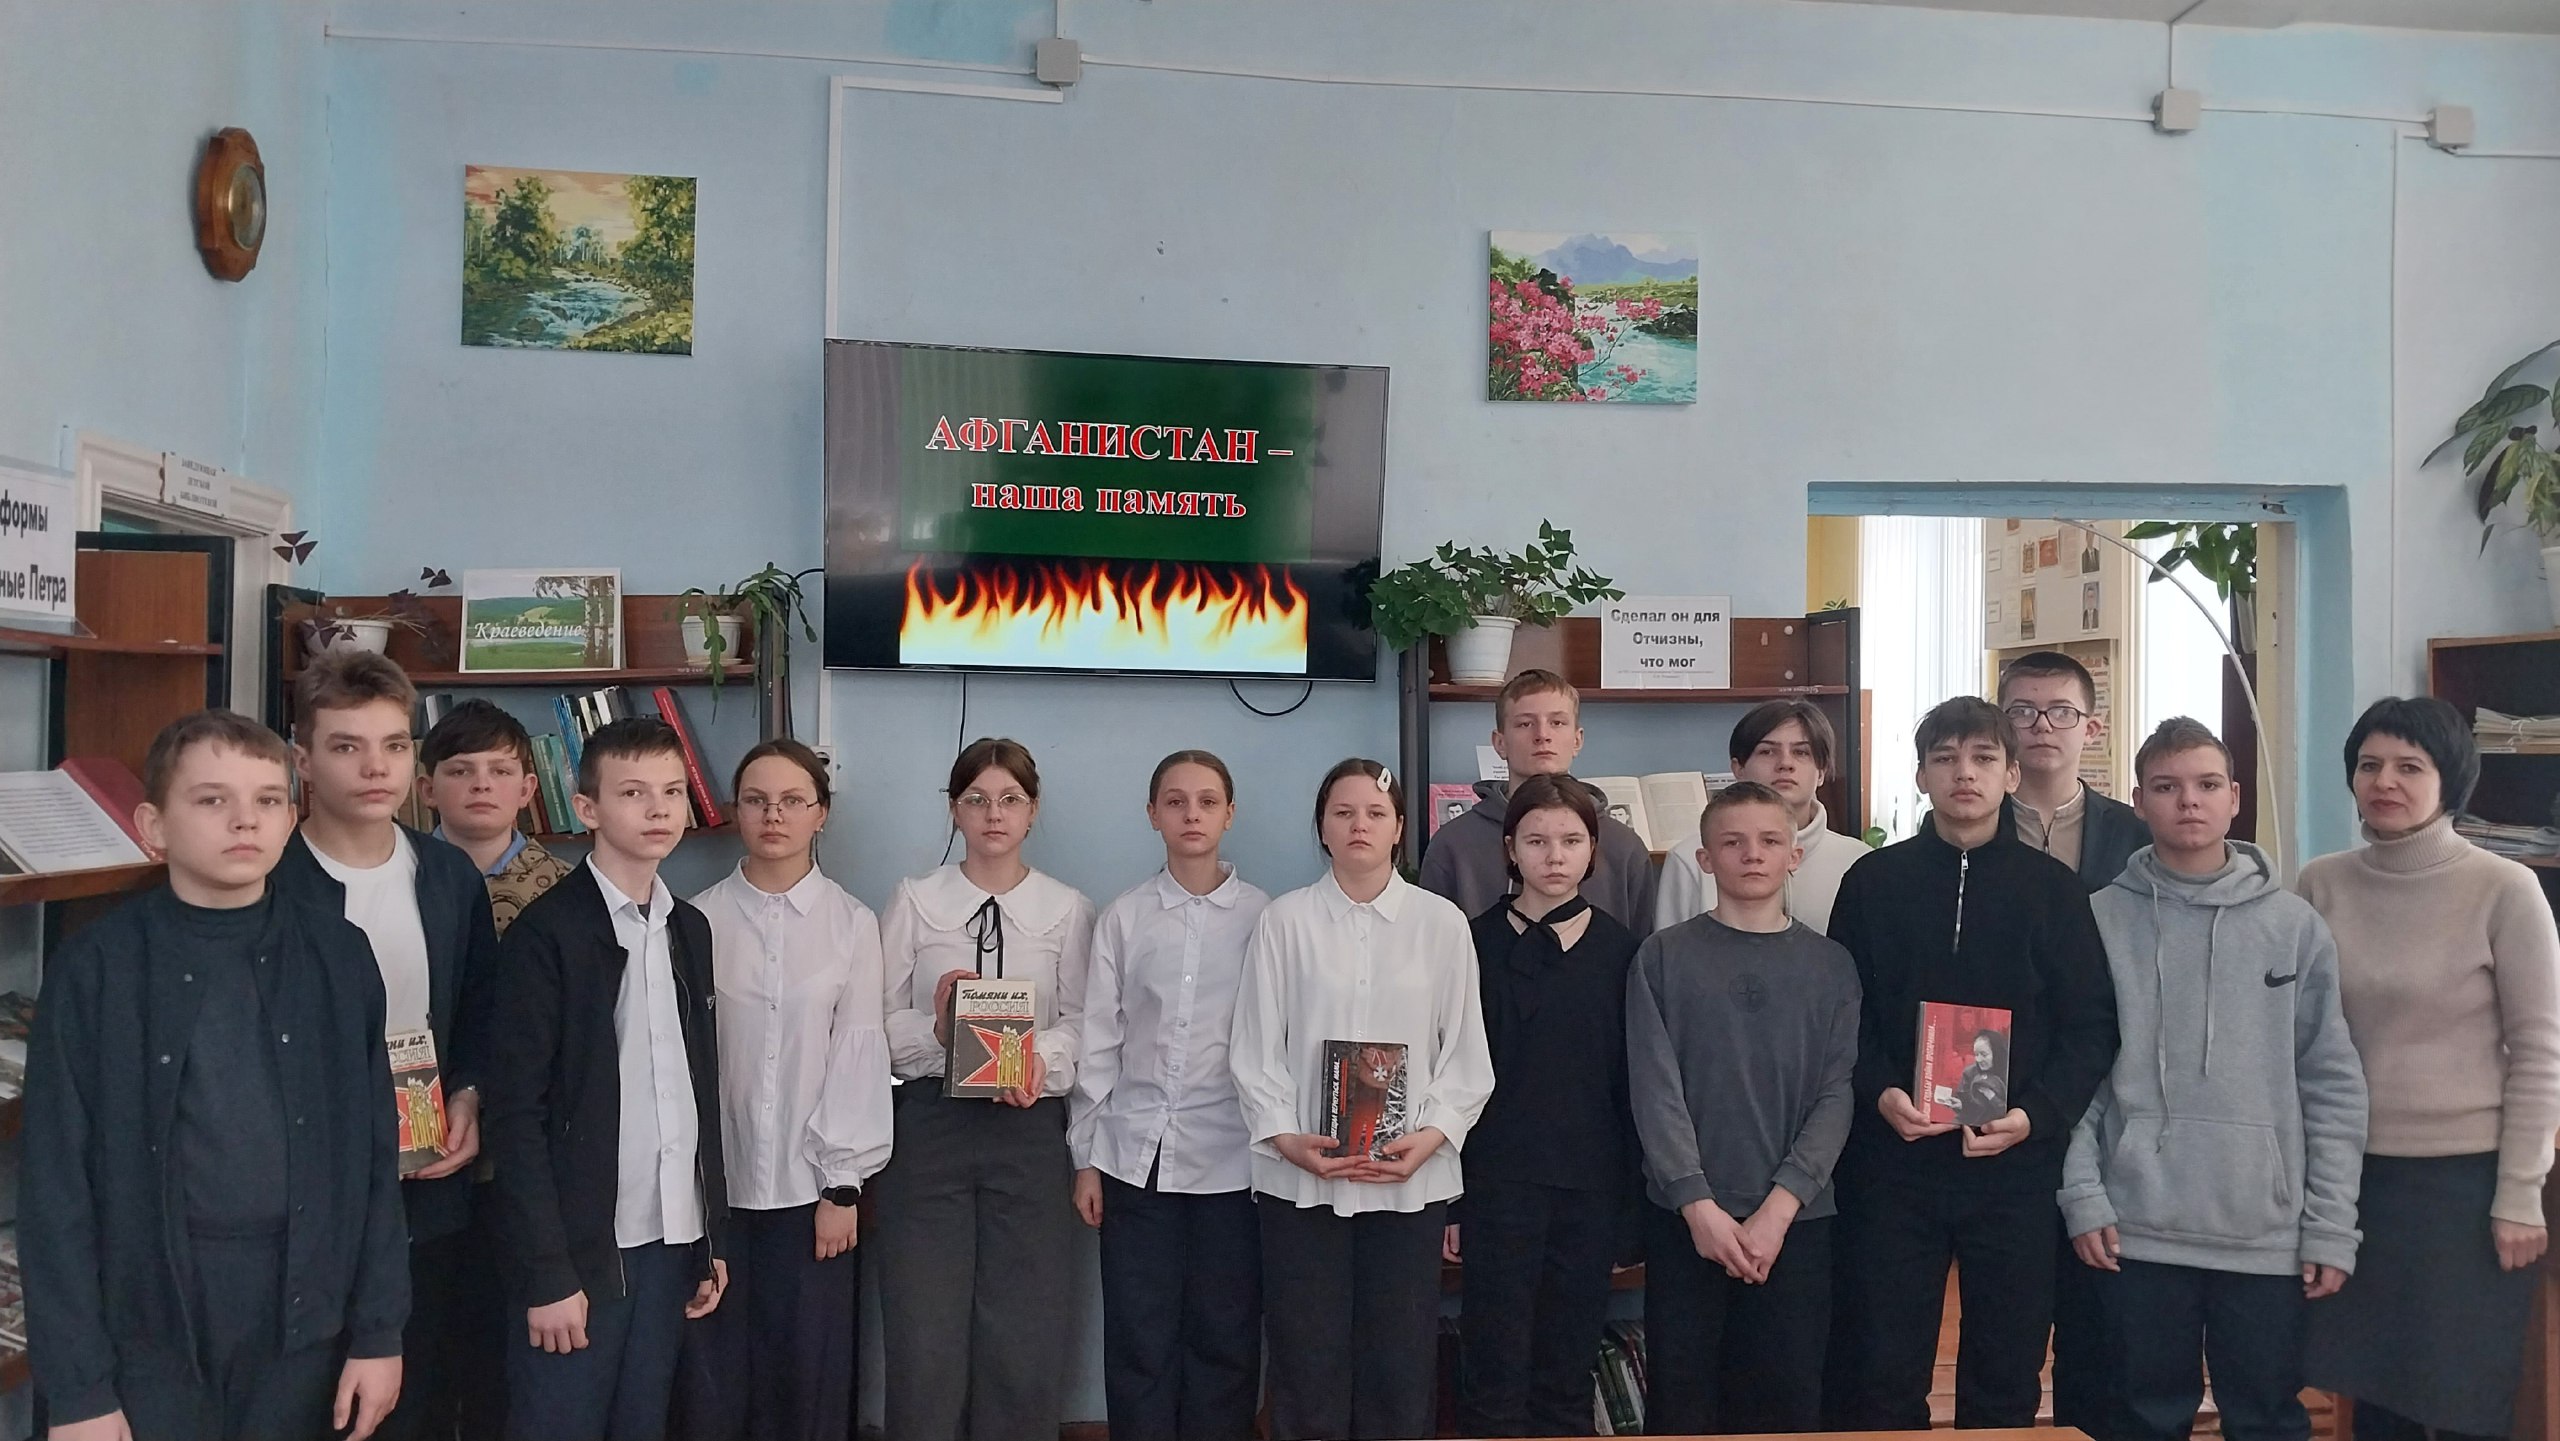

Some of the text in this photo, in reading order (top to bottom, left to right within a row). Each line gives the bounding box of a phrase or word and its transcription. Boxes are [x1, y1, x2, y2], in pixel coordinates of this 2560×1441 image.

[925, 414, 1259, 463] АФГАНИСТАН
[971, 483, 1247, 518] наша память
[0, 489, 48, 538] формы
[29, 563, 66, 611] Петра
[1611, 609, 1720, 624] Сделал он для
[474, 622, 584, 640] Краеведение
[1632, 631, 1703, 647] Отчизны,
[1640, 658, 1696, 668] что мог
[961, 988, 1009, 1000] Помяни
